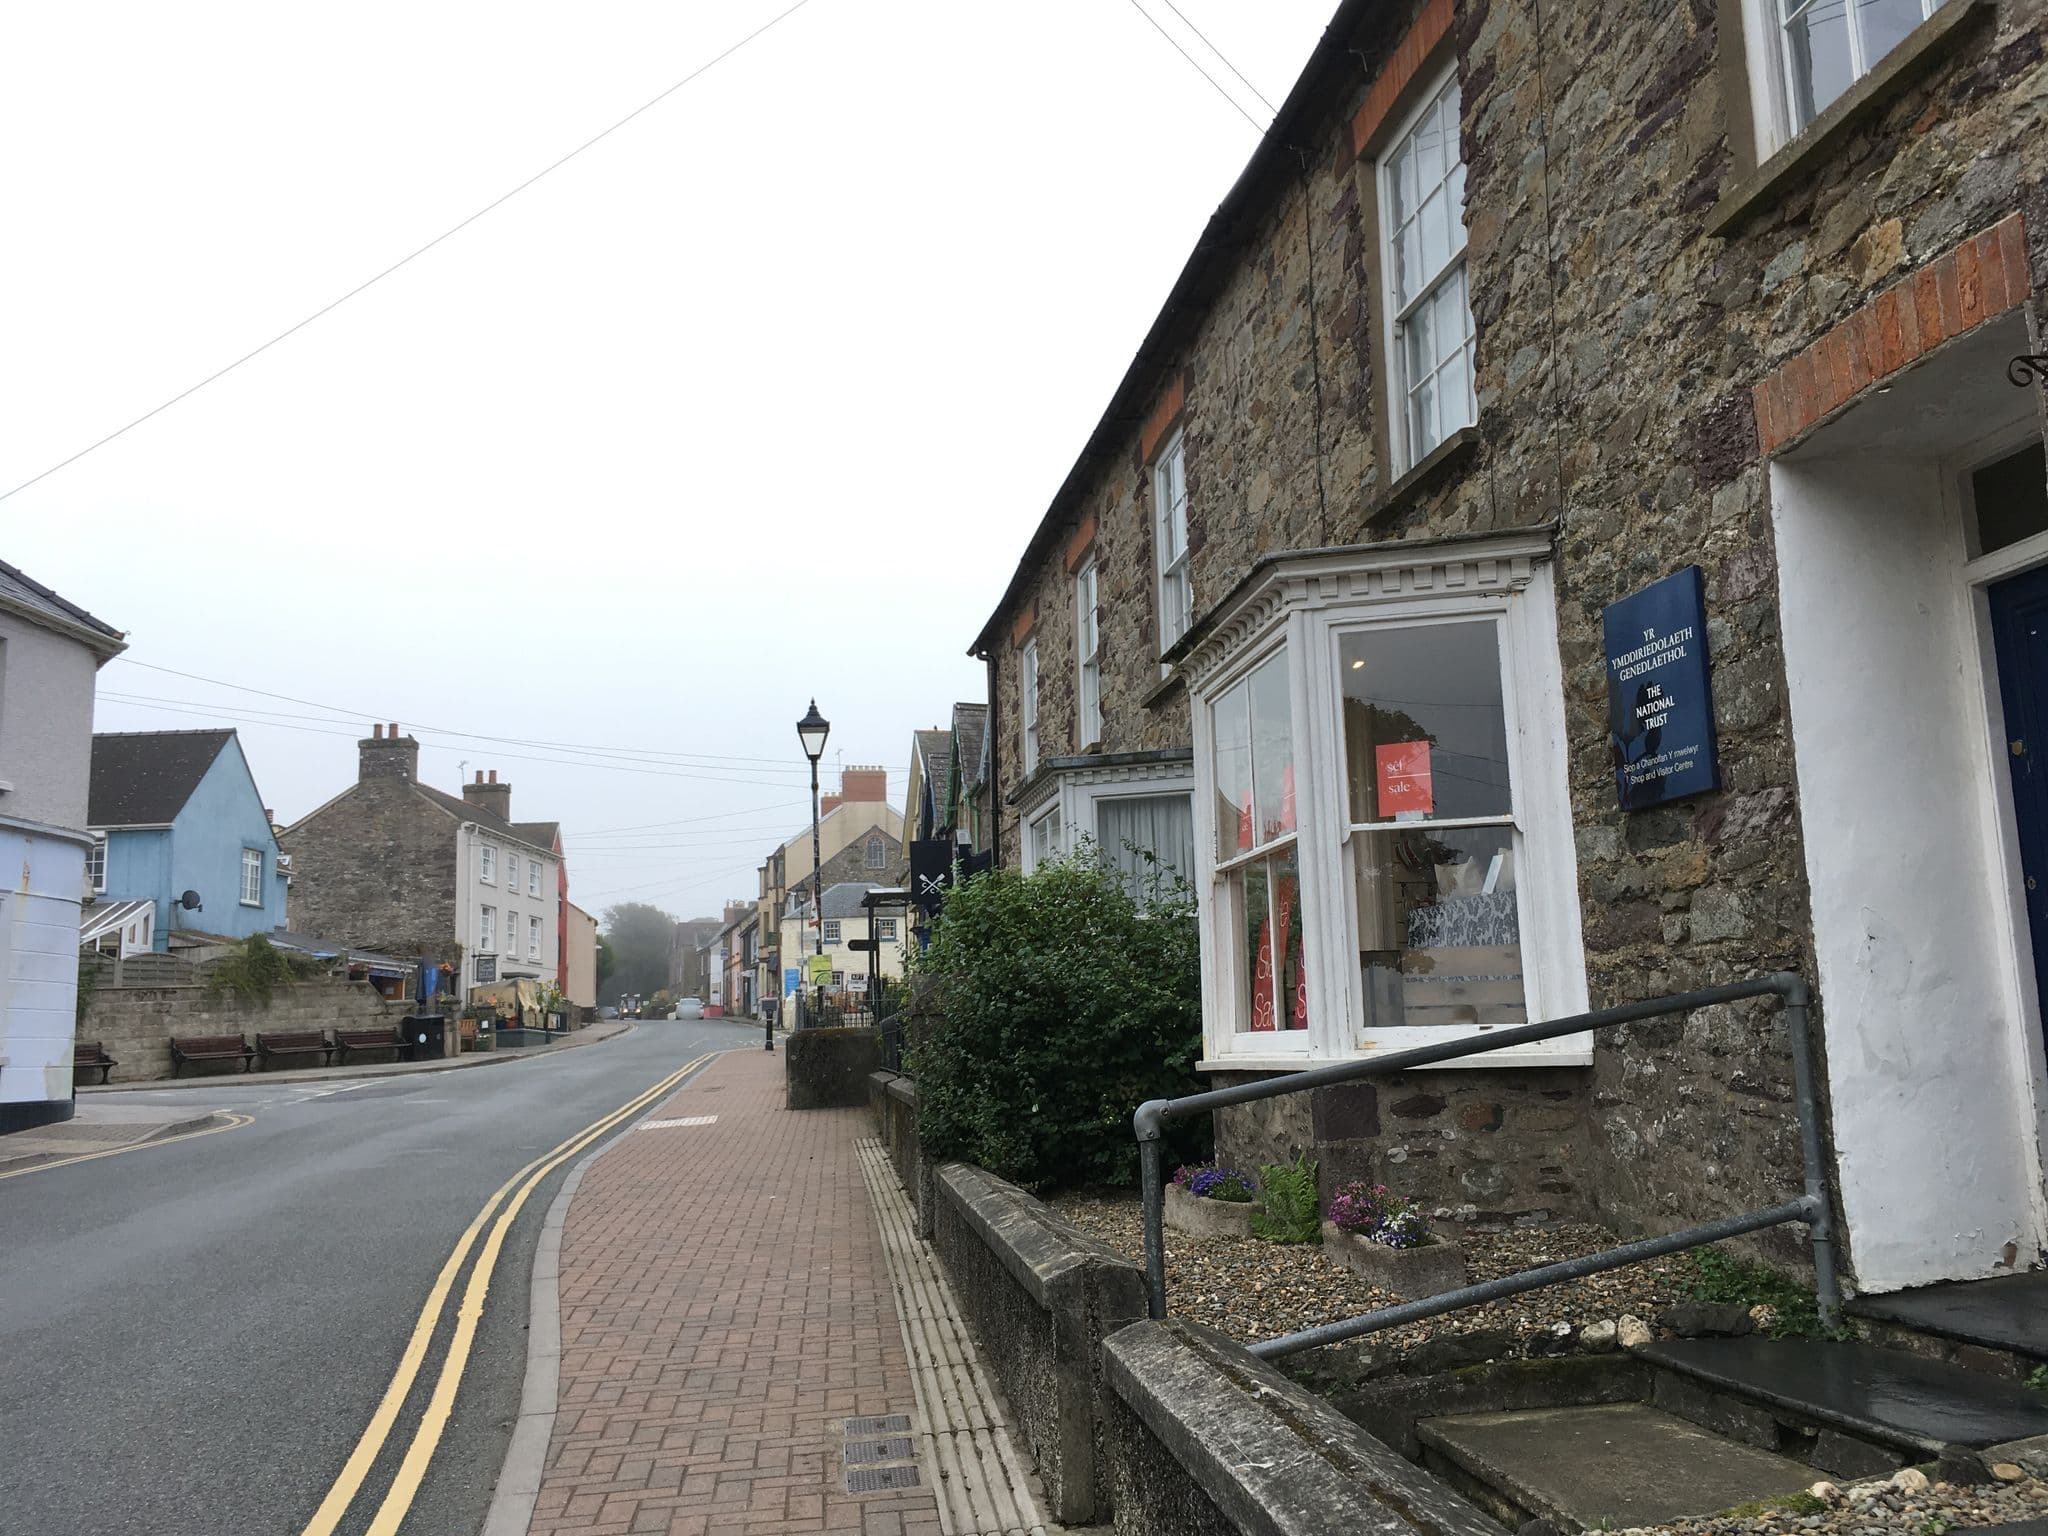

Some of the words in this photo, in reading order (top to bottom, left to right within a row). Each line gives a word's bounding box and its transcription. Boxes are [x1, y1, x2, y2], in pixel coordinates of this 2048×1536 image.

[1643, 627, 1655, 640] YR
[1611, 627, 1693, 670] YMDDIRIEDOLAETH
[1619, 645, 1687, 682] GENEDLAETHOL
[1646, 684, 1661, 699] THE
[1636, 695, 1675, 718] NATIONAL
[1644, 713, 1668, 731] TRUST
[1630, 774, 1645, 785] Shop
[1645, 769, 1656, 781] and
[1656, 764, 1674, 777] Visitor
[1674, 760, 1694, 772] Centre
[1388, 781, 1410, 793] sale
